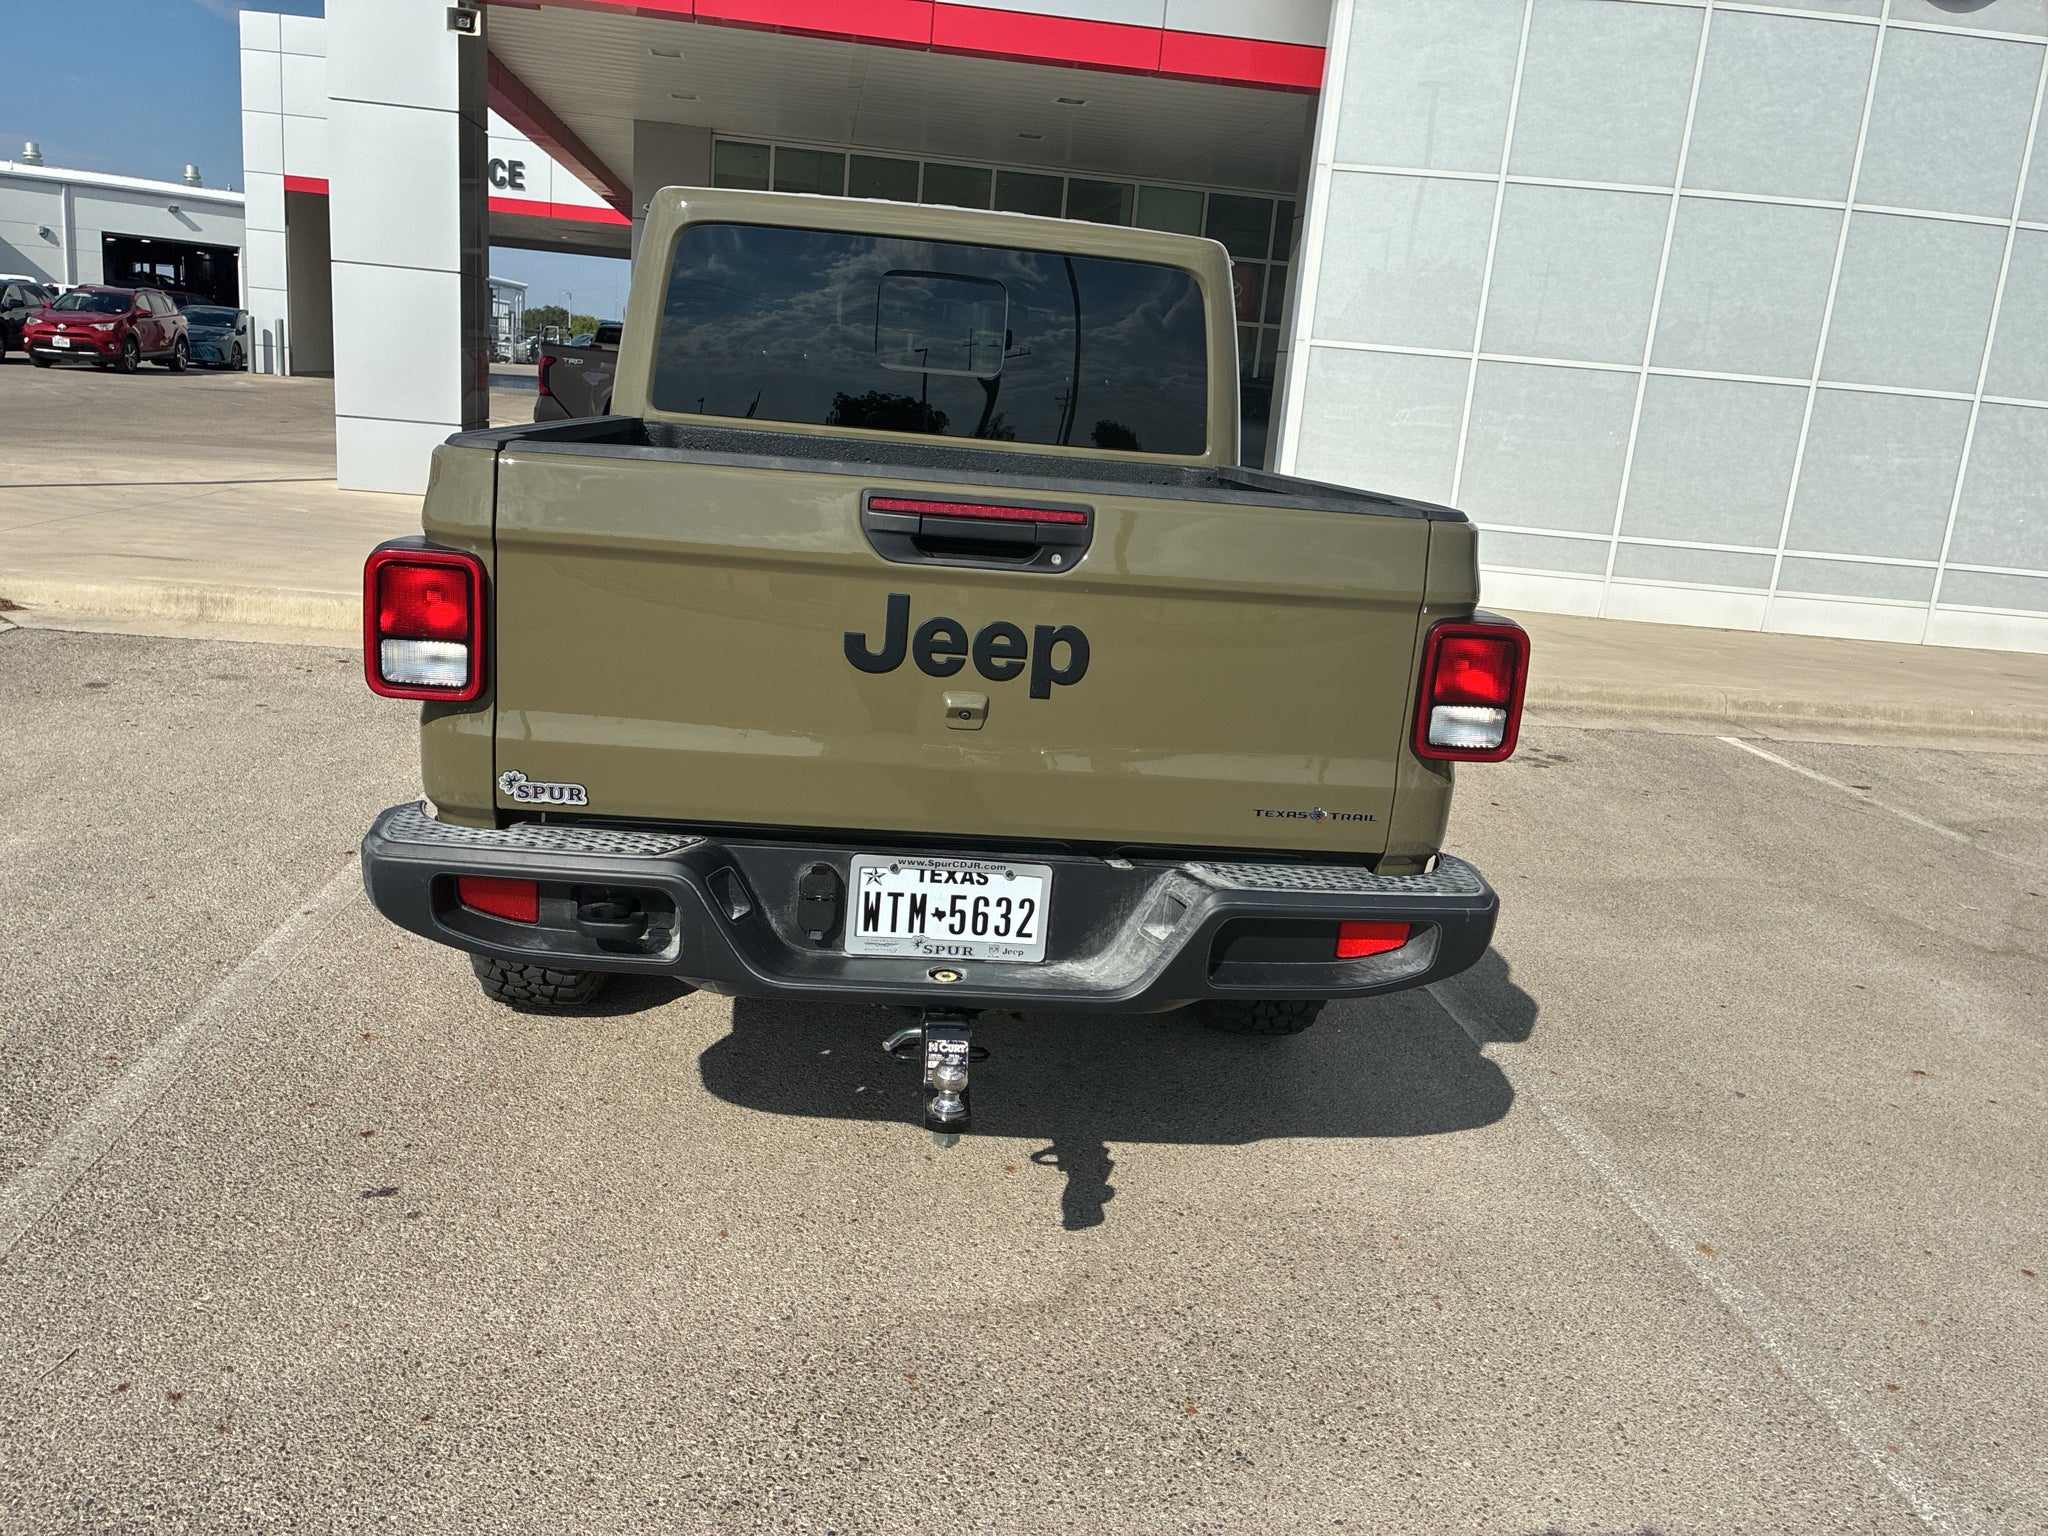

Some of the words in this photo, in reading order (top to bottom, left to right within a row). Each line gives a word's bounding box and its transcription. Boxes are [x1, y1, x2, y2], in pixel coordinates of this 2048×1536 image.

[562, 357, 584, 365] TRD
[844, 592, 1090, 699] Jeep
[517, 784, 583, 802] SPUR
[1253, 809, 1307, 819] TEXAS
[1330, 812, 1377, 821] TRAIL
[898, 858, 1006, 872] www.SpurCDJR.com
[916, 868, 989, 886] TEXAS
[923, 943, 975, 956] SPUR
[1002, 947, 1024, 957] Jeep
